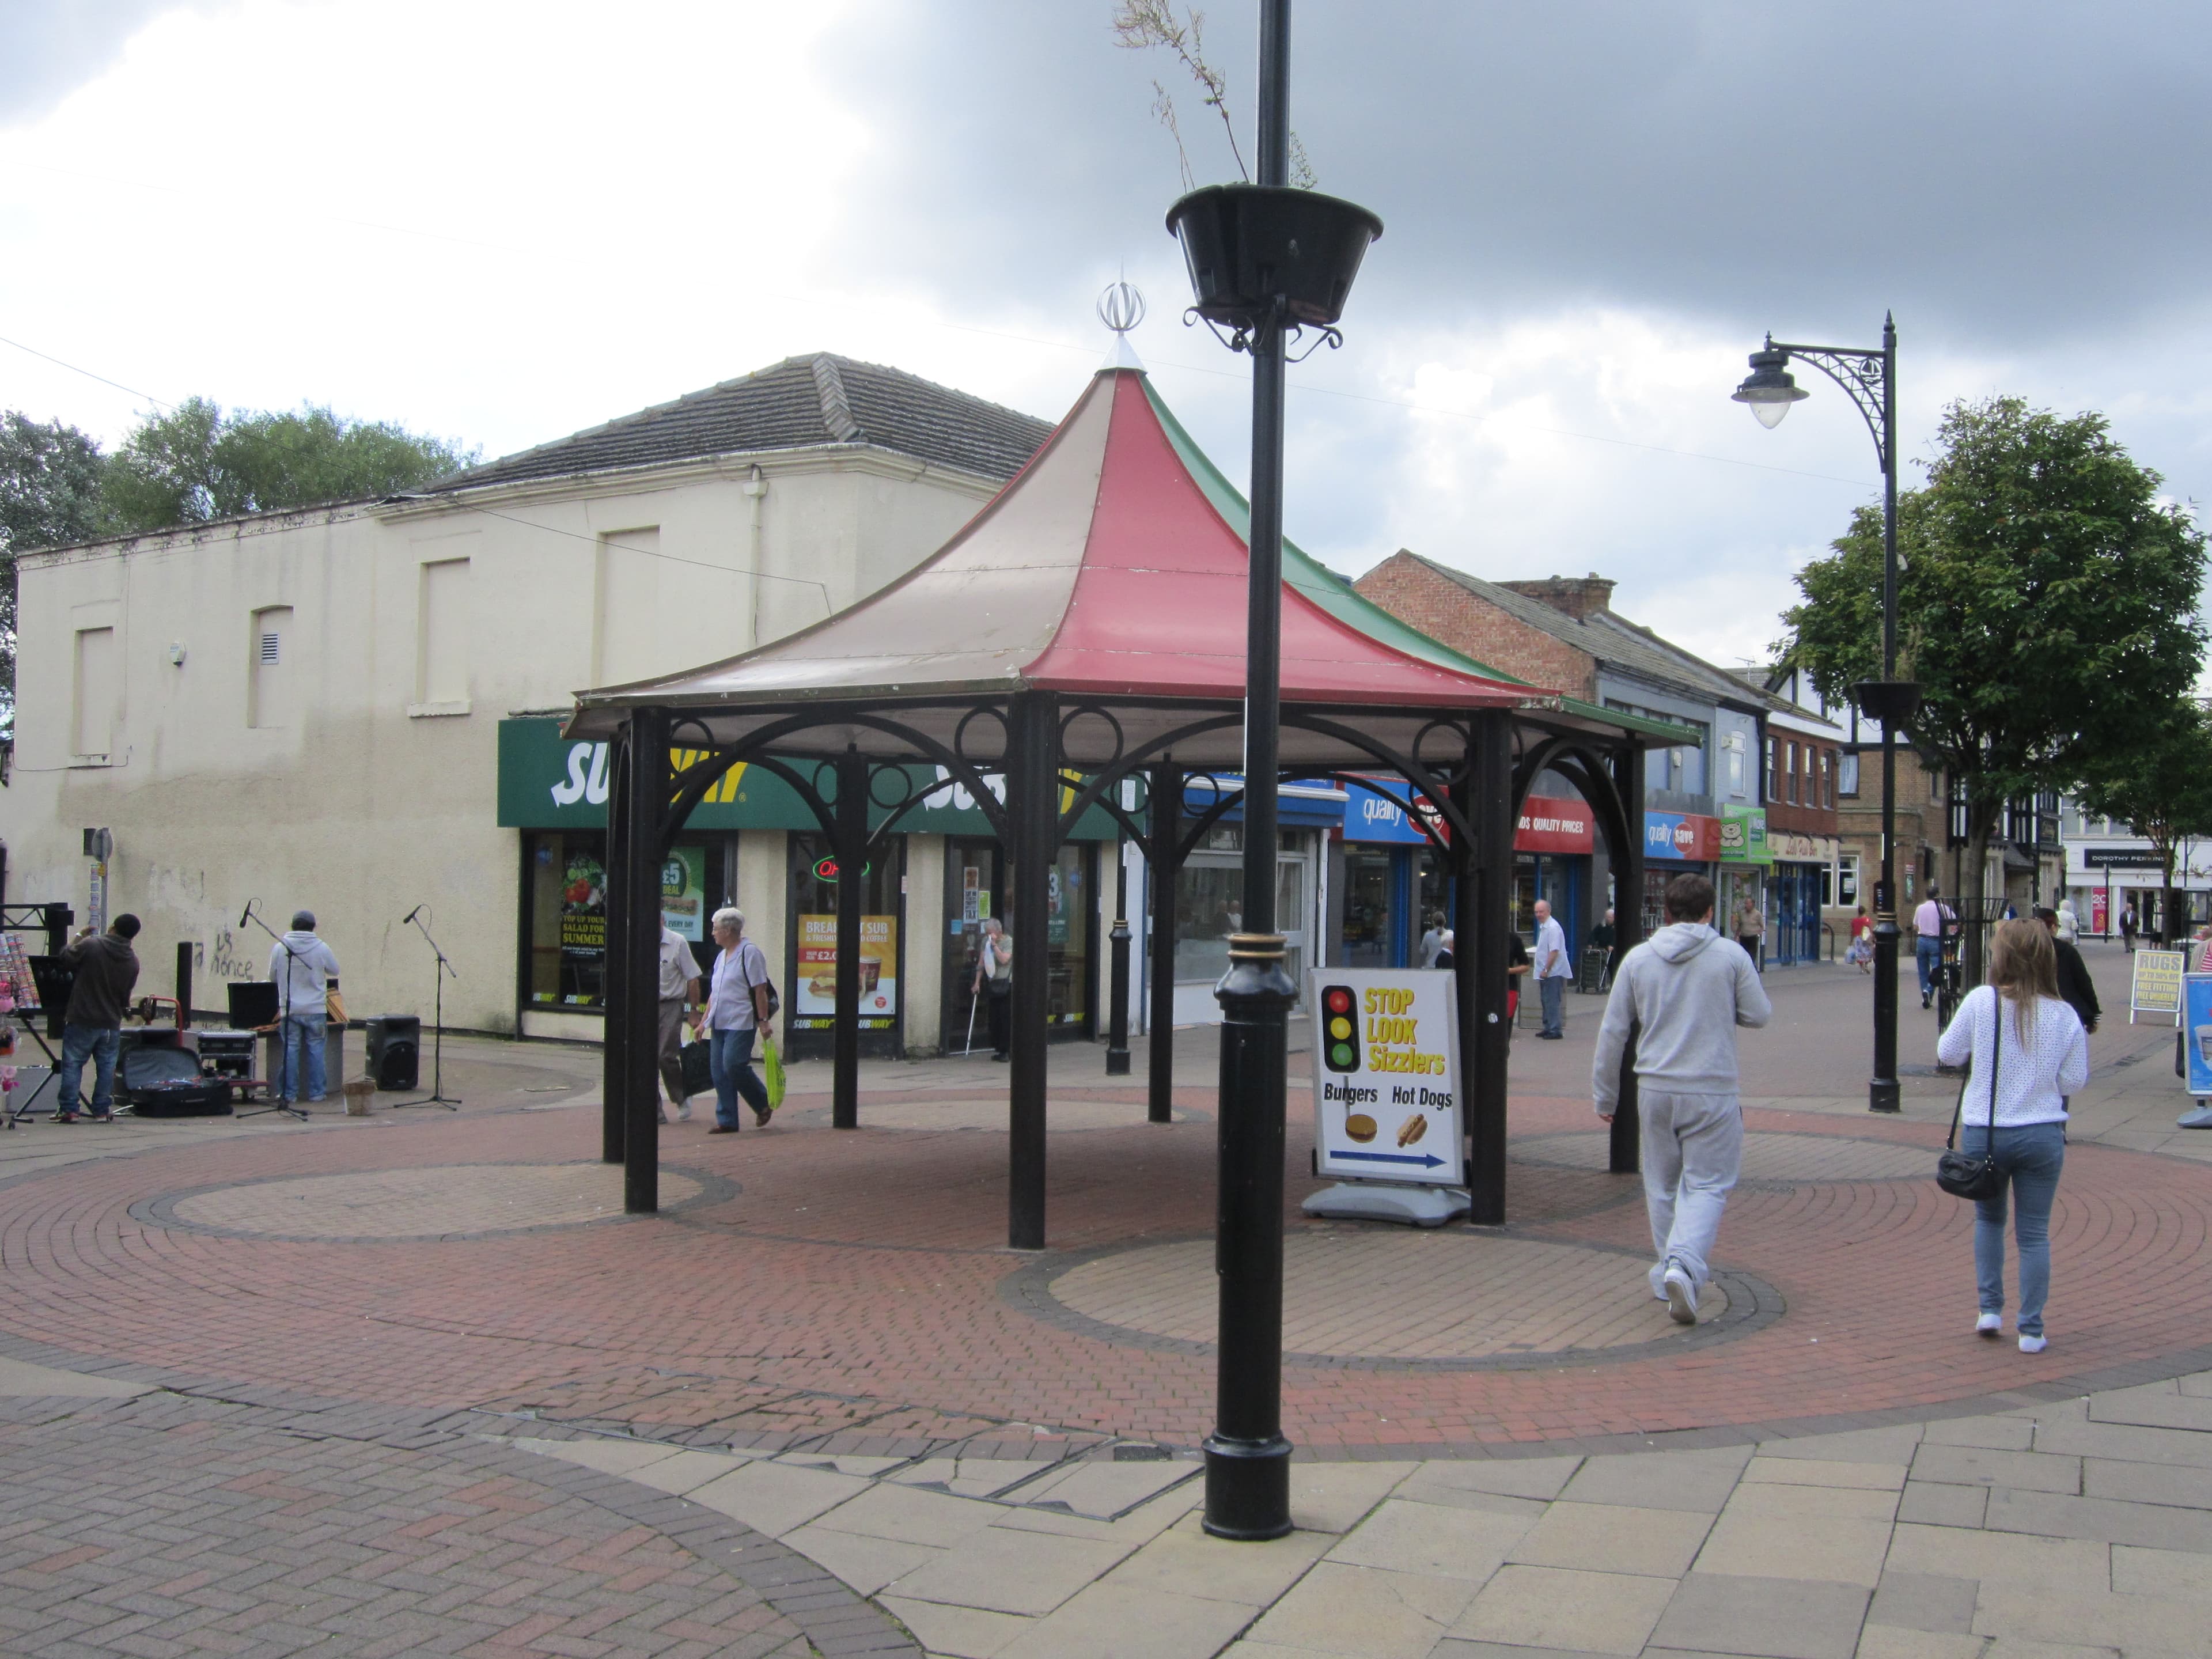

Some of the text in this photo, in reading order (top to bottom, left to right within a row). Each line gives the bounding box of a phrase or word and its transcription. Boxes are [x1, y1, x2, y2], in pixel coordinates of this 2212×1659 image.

[1533, 817, 1560, 831] QUALITY
[1562, 820, 1584, 834] PRICES
[1649, 823, 1694, 847] quality save
[662, 863, 680, 885] £5
[563, 923, 604, 933] SALAD FOR
[867, 923, 889, 934] SUB
[563, 933, 604, 945] SUMMER
[2139, 955, 2181, 971] RUGS
[564, 994, 593, 1005] SUBWAY
[1364, 987, 1415, 1015] STOP
[793, 1018, 835, 1029] SUBWAY
[858, 1018, 895, 1029] UBWAY
[1366, 1017, 1418, 1044] LOOK
[1368, 1044, 1446, 1075] Sizzlers
[1324, 1083, 1378, 1106] Burgers
[1392, 1086, 1453, 1111] Hot Dogs
